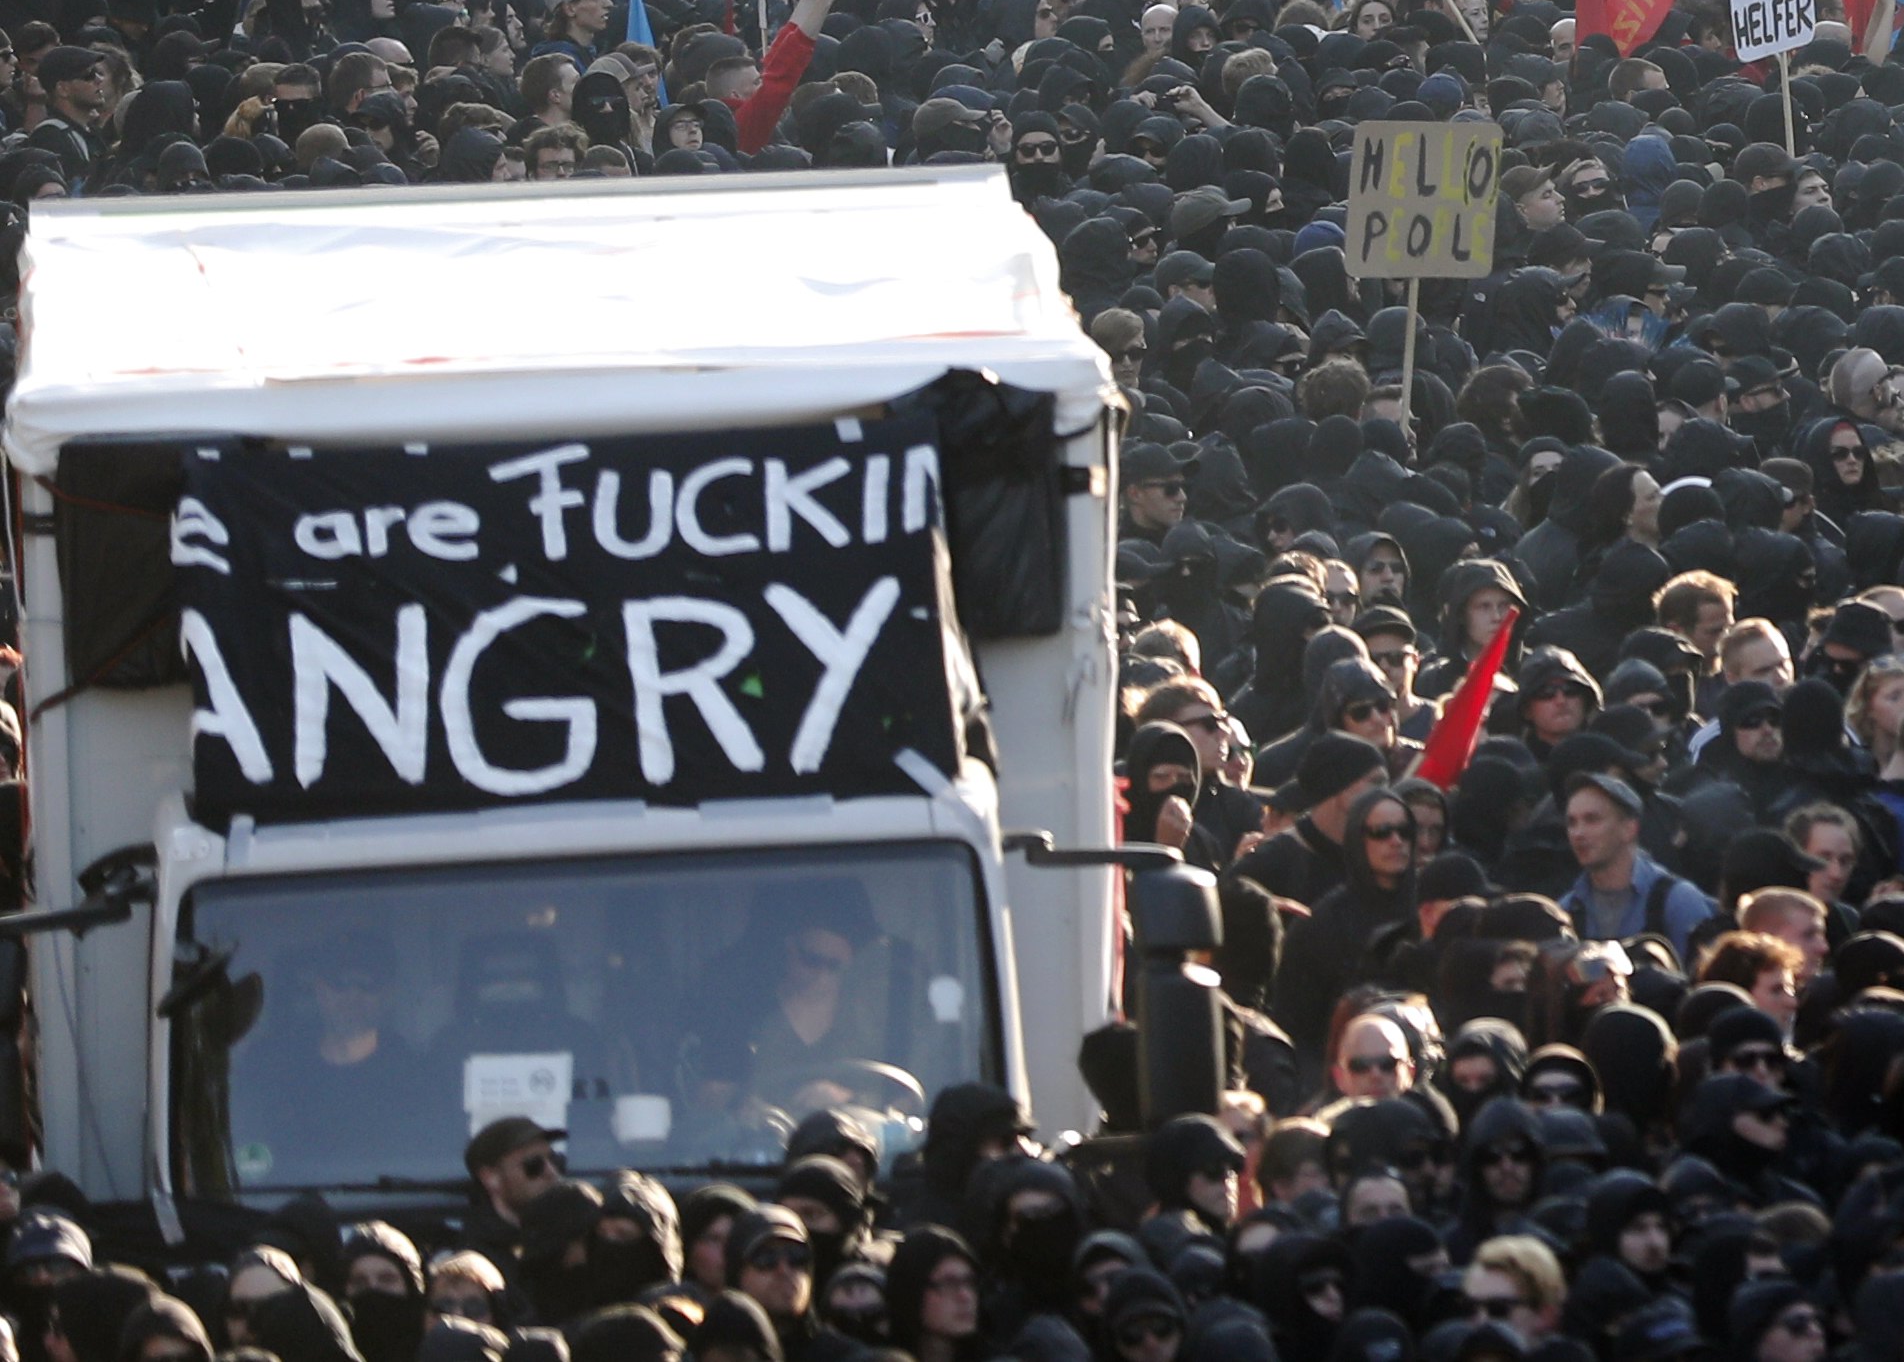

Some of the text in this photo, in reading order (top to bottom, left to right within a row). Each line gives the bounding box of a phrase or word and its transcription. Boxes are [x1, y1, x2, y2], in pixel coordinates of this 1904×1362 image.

[1362, 207, 1489, 265] PEOPLE
[293, 498, 481, 561] are
[181, 576, 902, 797] ANGRY
